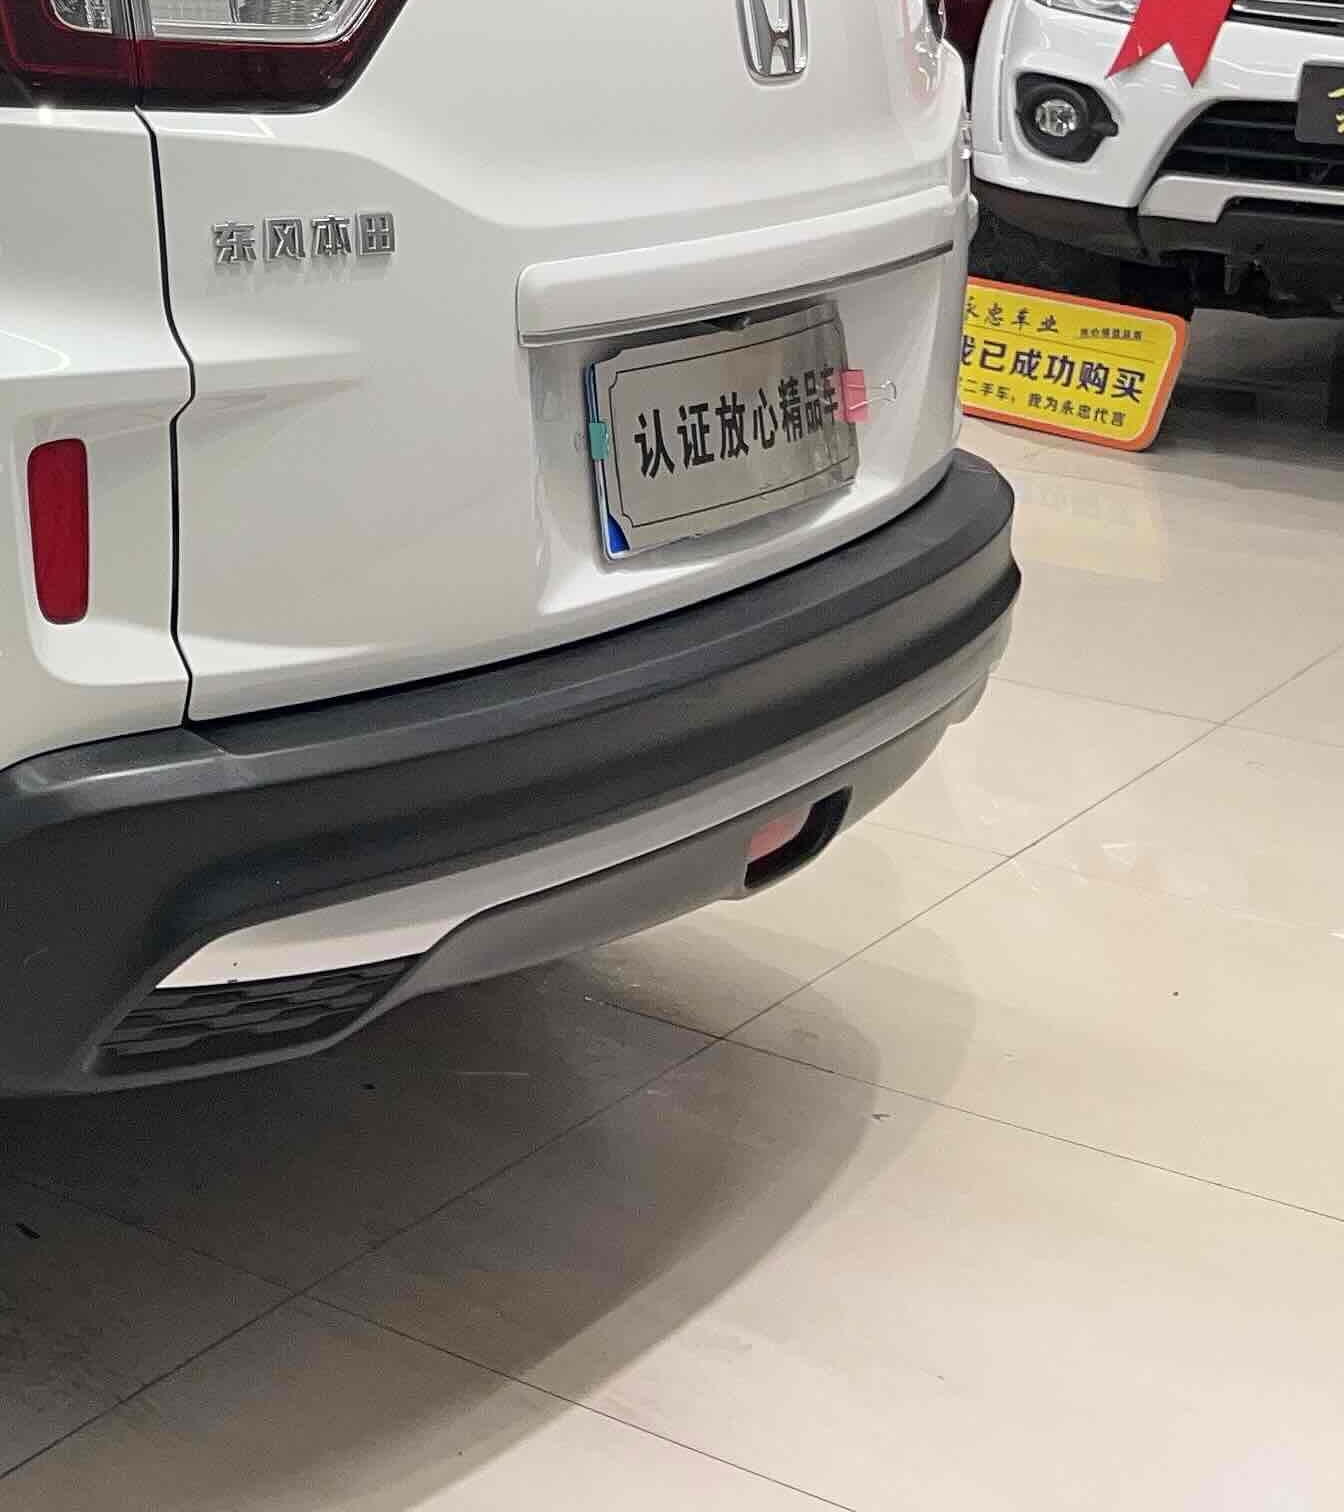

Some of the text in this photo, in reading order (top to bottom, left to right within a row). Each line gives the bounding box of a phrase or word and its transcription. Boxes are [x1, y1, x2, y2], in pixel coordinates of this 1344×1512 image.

[214, 215, 396, 264] 东风本田
[959, 376, 1128, 429] 二手车，我为永忠代言
